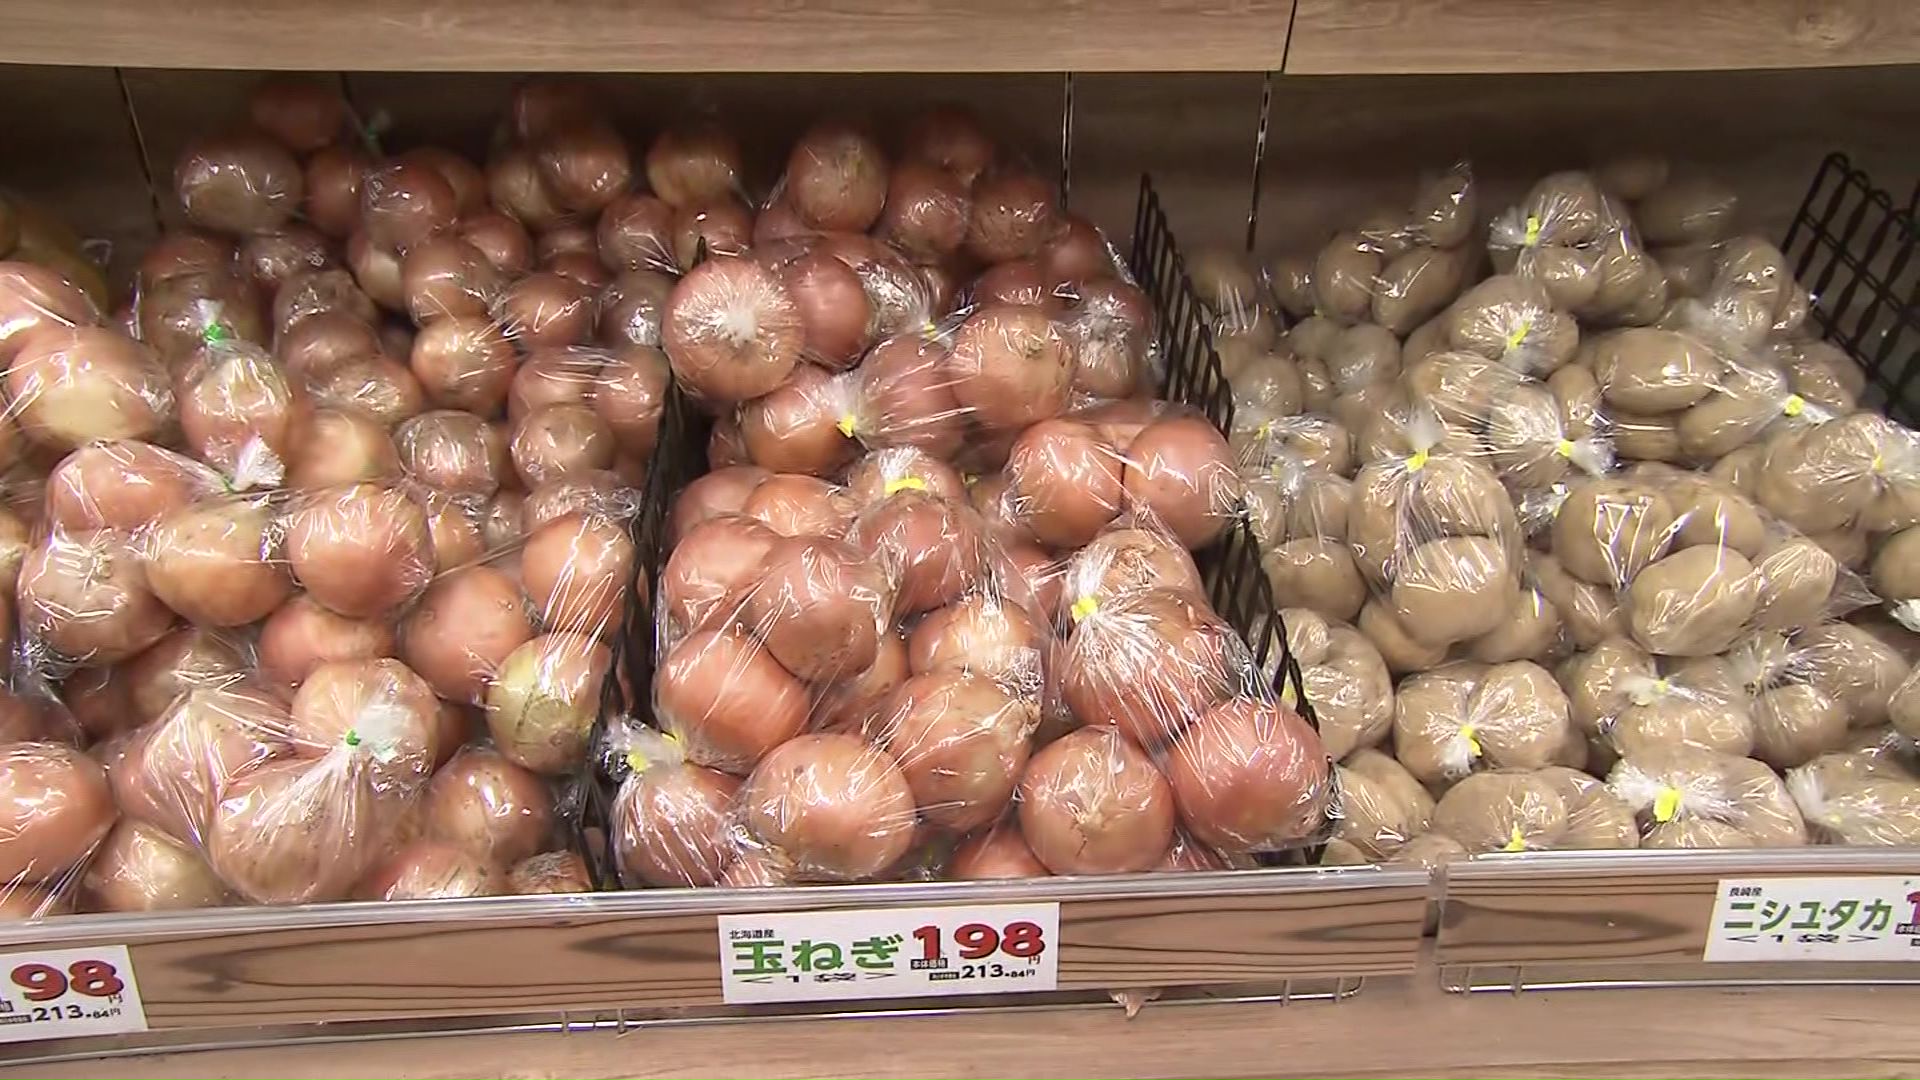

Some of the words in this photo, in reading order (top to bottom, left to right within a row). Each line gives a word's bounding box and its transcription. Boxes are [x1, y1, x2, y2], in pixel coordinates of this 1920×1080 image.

[729, 929, 774, 939] 北海道産
[913, 922, 1045, 960] 198
[732, 934, 904, 975] 玉ねぎ
